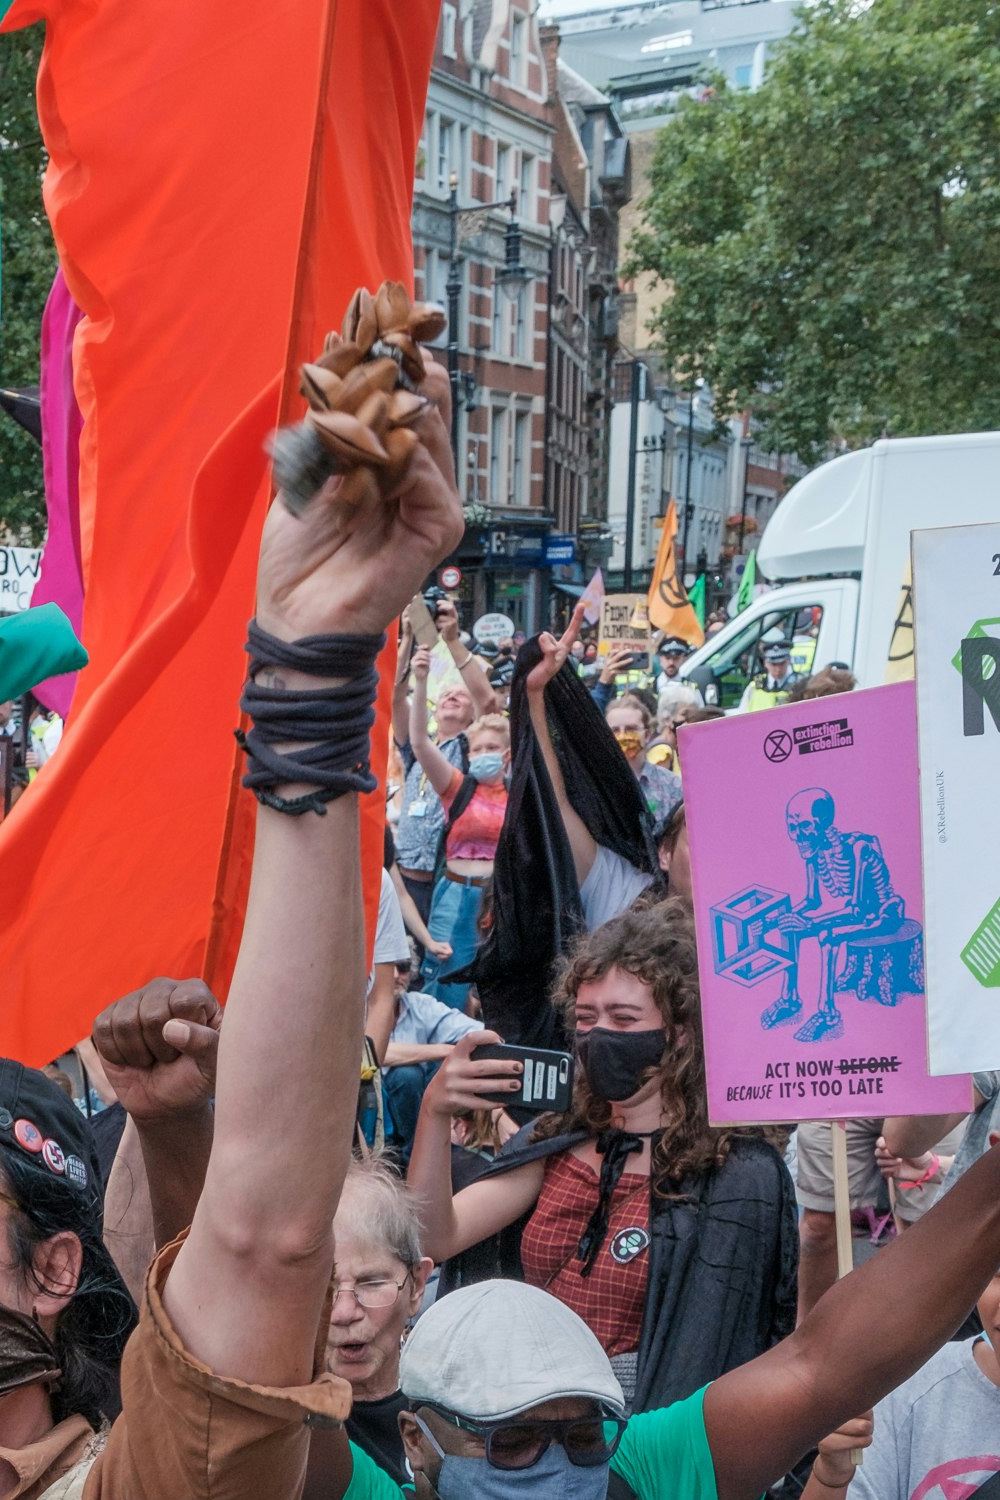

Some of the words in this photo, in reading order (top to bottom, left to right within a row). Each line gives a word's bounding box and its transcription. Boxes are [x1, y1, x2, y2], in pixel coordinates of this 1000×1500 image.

[795, 723, 841, 740] extinction
[810, 734, 852, 751] rebellion
[936, 770, 947, 843] @XRebellionUK
[765, 1062, 791, 1079] ACT
[796, 1060, 834, 1077] NOW
[839, 1056, 898, 1075] BEFORE
[726, 1084, 774, 1101] BECAUSE
[779, 1082, 805, 1098] IT'S
[811, 1080, 843, 1096] TOO
[848, 1078, 884, 1095] LATE
